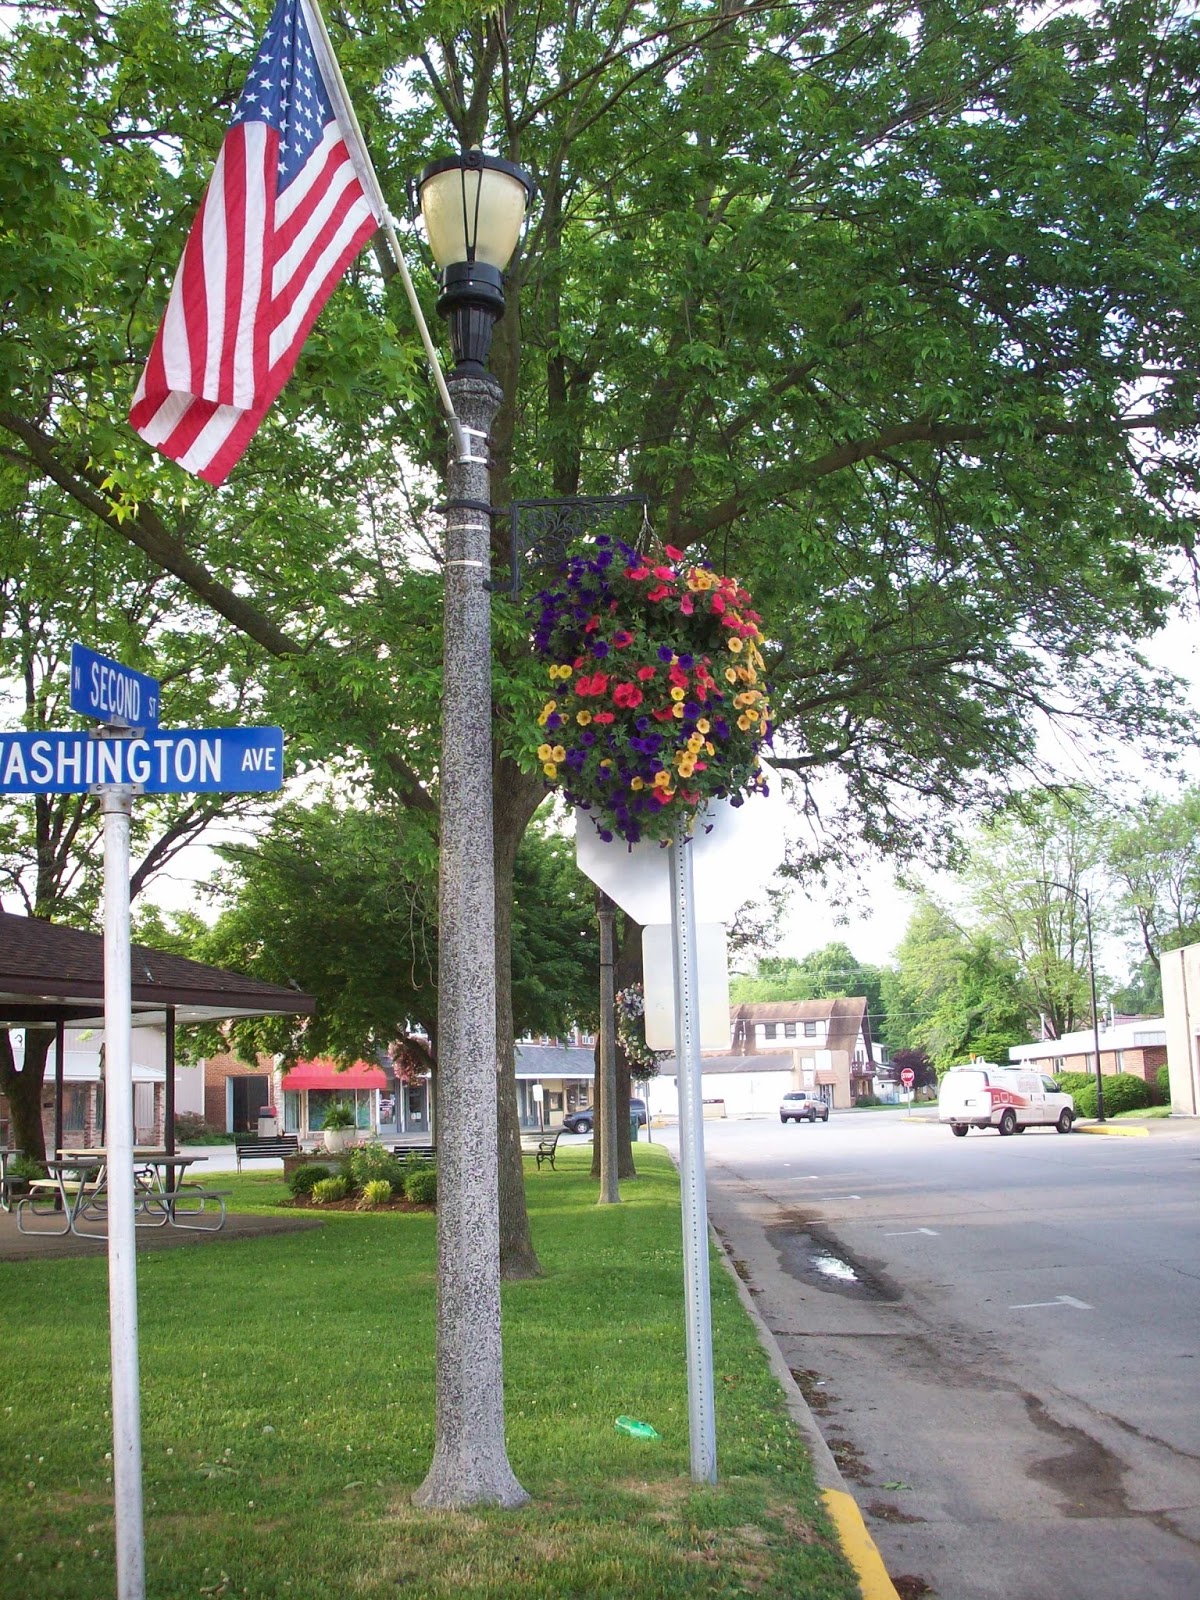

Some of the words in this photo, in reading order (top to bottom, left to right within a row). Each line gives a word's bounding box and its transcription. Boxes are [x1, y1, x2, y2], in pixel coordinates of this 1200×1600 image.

[74, 666, 81, 690] N
[90, 661, 140, 721] SECOND
[148, 696, 157, 718] ST
[0, 738, 222, 785] ASHINGTON
[241, 747, 276, 771] AVE
